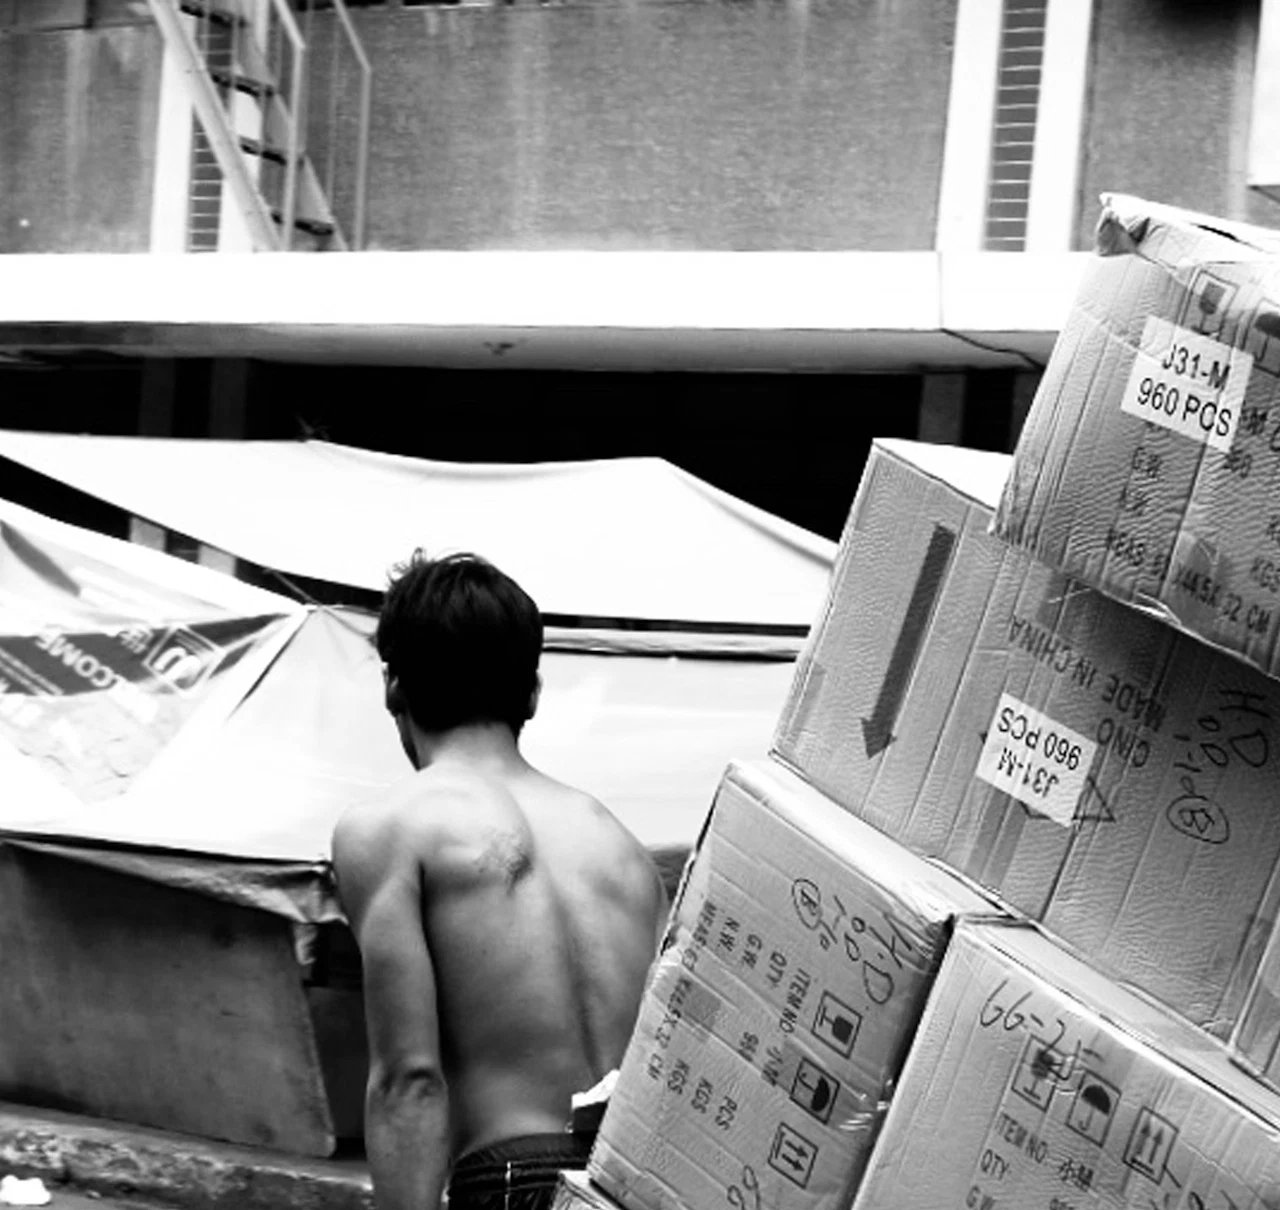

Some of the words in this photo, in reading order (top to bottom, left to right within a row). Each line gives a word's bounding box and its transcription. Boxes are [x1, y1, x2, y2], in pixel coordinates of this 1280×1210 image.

[1162, 343, 1231, 391] J31-M
[1137, 377, 1179, 417] 960
[1182, 393, 1232, 436] PCS
[1008, 615, 1071, 674] CHINA
[997, 707, 1042, 750] PCS
[996, 747, 1061, 798] J31-M
[1043, 732, 1083, 771] 960
[666, 1058, 691, 1097] KGS
[690, 1077, 714, 1115] KGS
[714, 1095, 738, 1131] PCS
